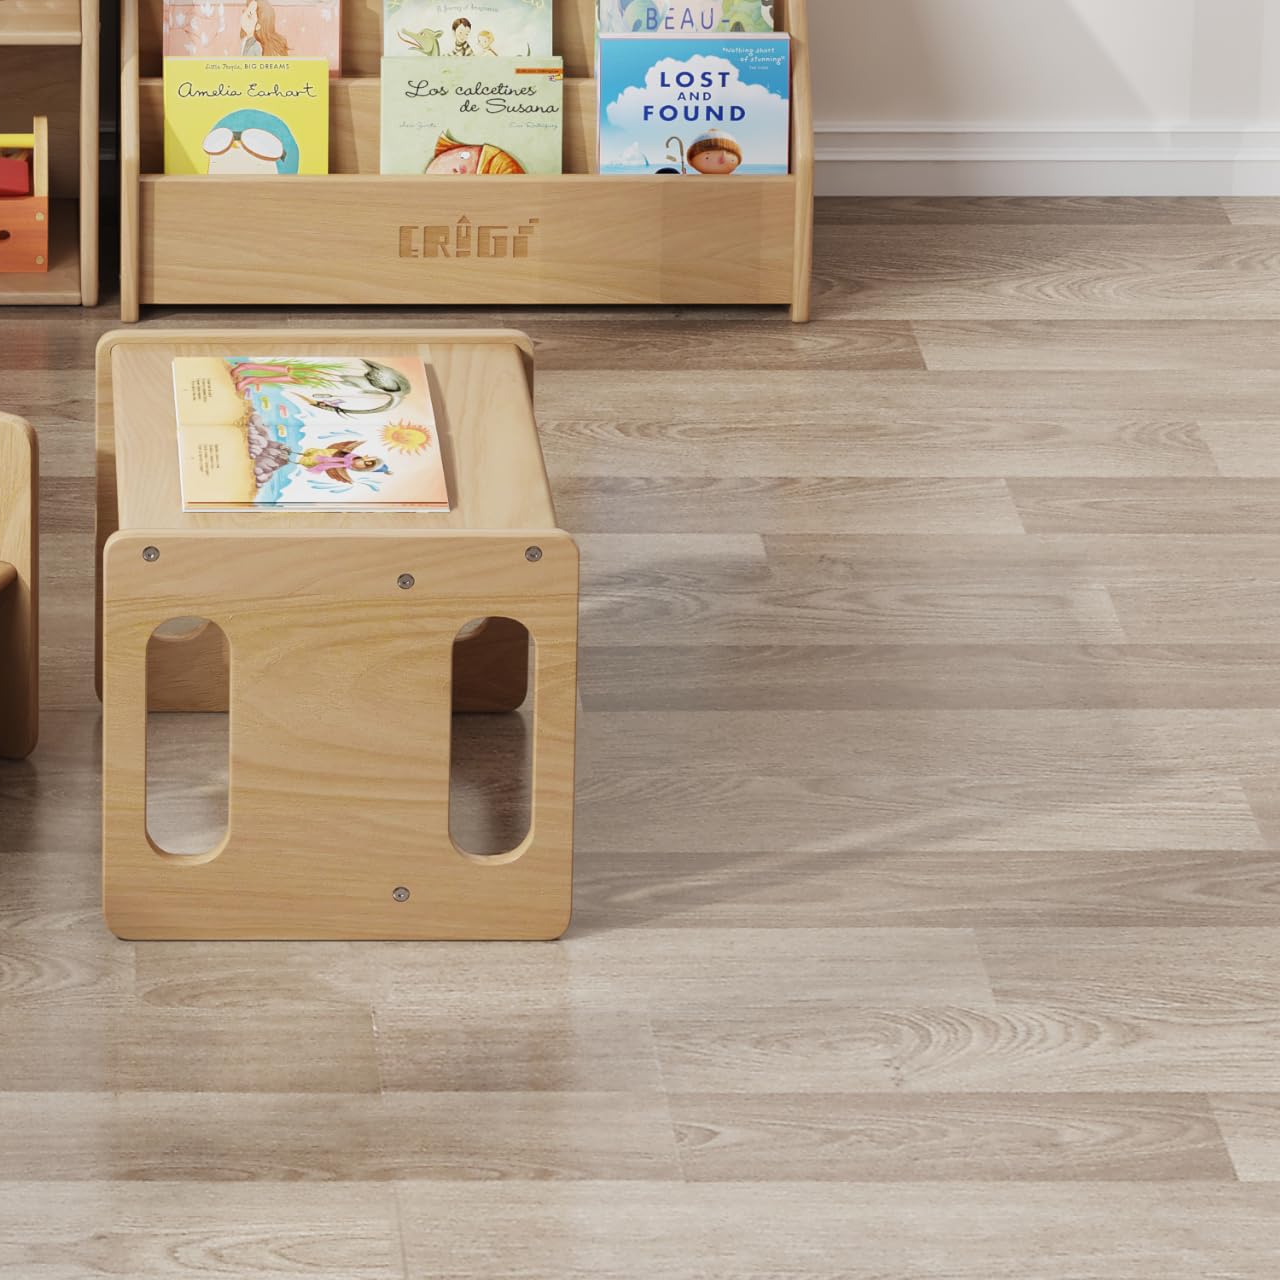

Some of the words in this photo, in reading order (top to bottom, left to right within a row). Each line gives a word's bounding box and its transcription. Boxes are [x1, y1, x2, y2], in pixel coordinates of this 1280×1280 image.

[660, 71, 731, 88] LOST
[178, 82, 242, 98] Amelia
[246, 82, 318, 98] Earhart
[405, 80, 449, 98] Los
[455, 81, 537, 97] calcetines
[677, 92, 712, 101] AND
[459, 100, 480, 113] de
[485, 98, 560, 114] Susana
[643, 105, 746, 121] FOUND
